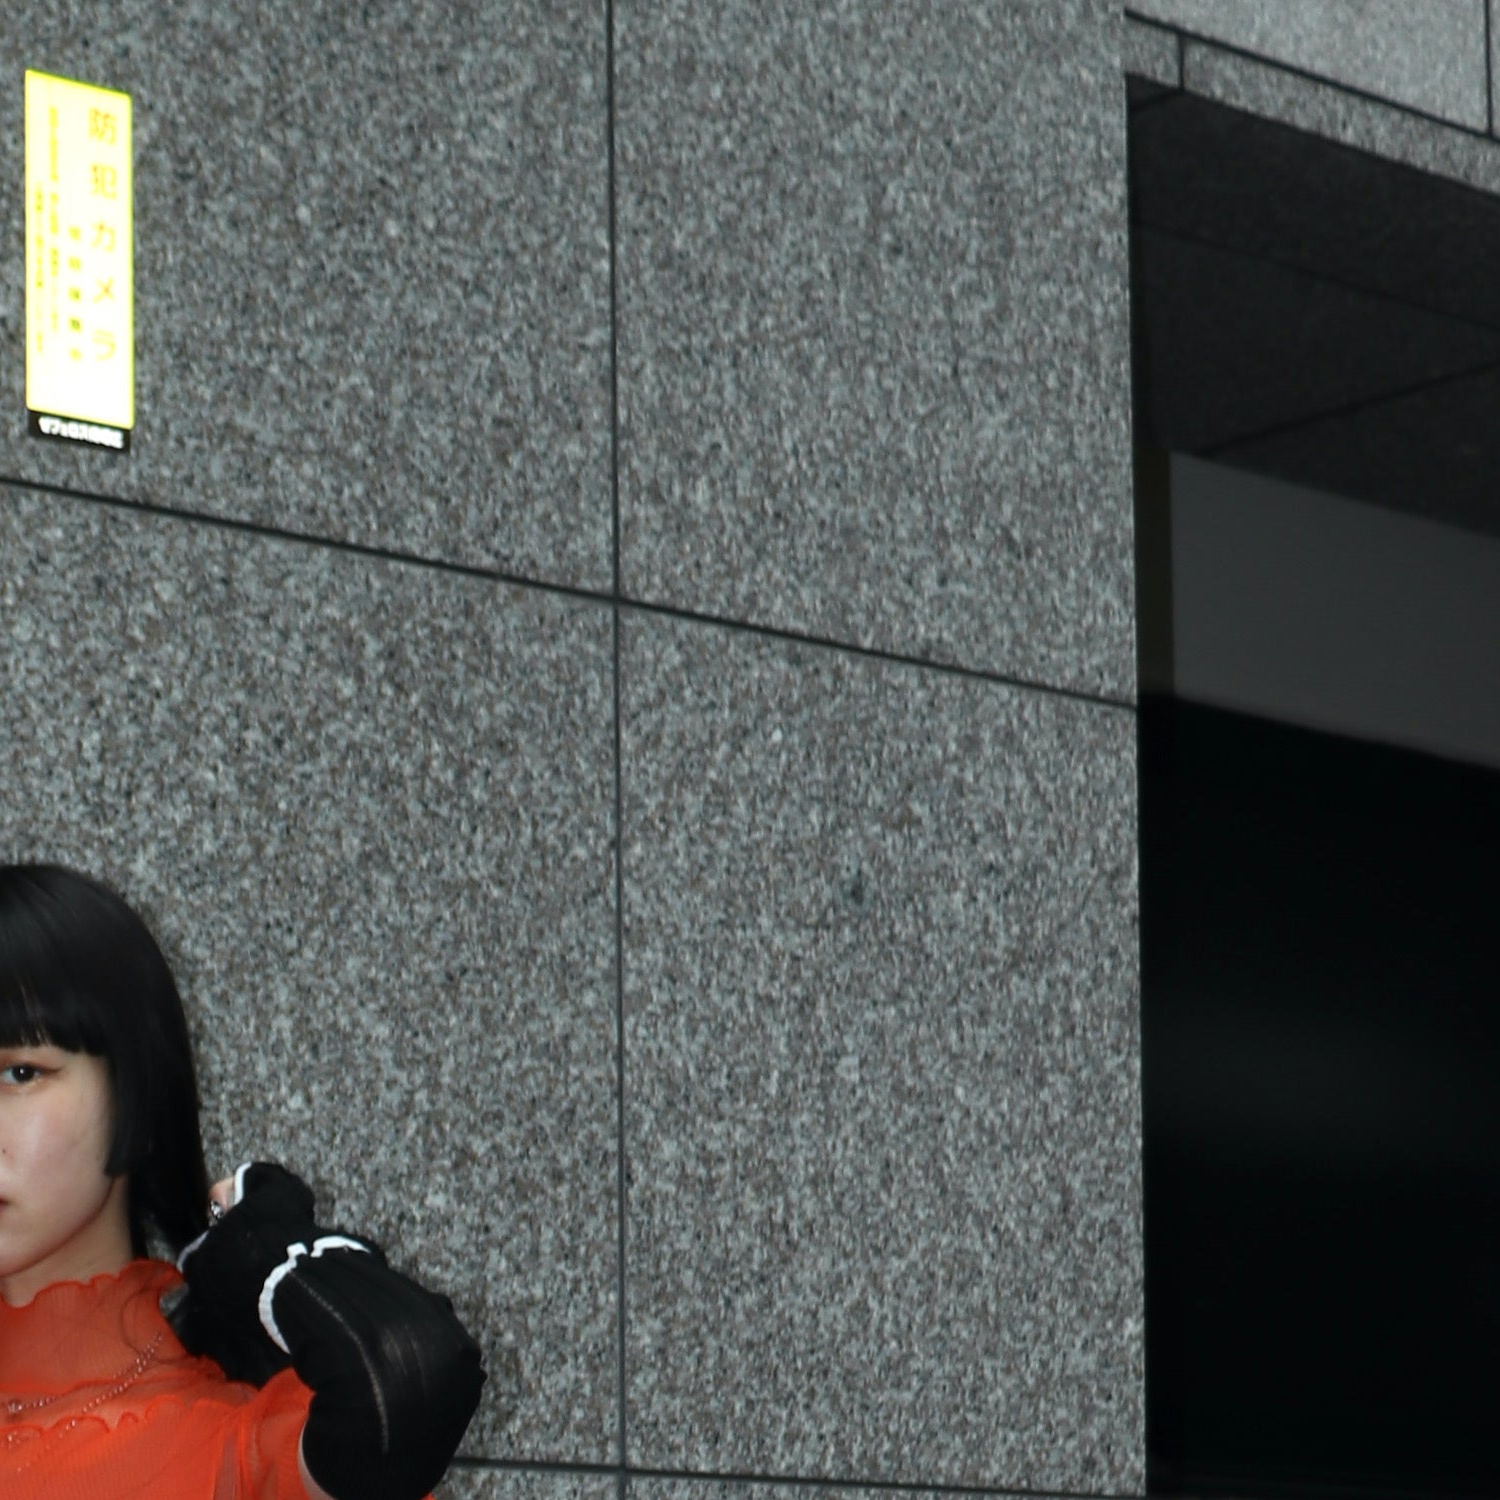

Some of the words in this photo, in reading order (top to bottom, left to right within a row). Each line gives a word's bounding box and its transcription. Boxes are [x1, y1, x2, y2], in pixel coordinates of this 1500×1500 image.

[88, 107, 119, 361] 防犯カメラ
